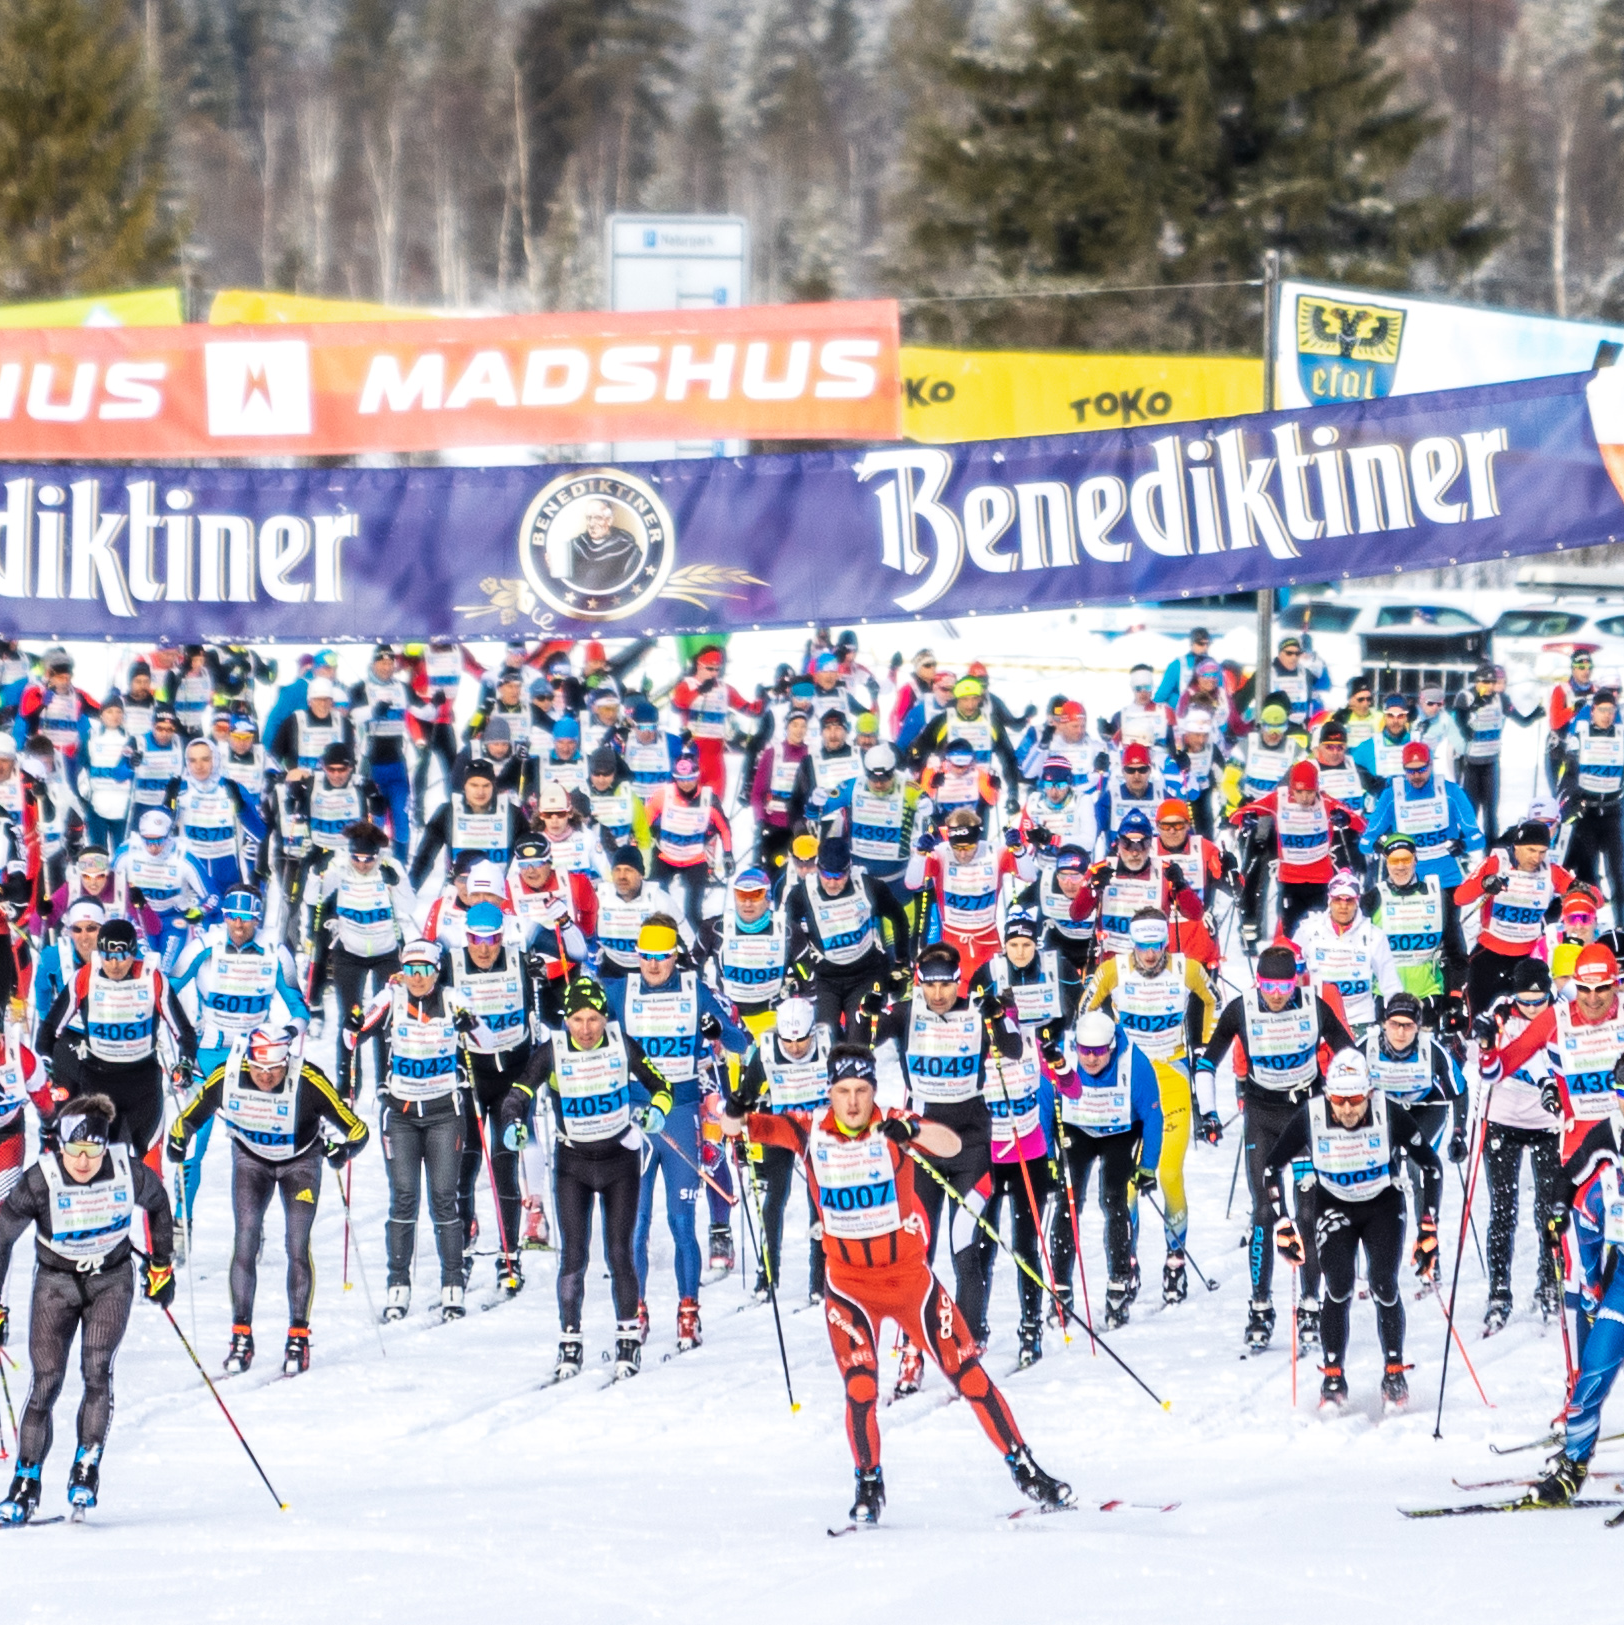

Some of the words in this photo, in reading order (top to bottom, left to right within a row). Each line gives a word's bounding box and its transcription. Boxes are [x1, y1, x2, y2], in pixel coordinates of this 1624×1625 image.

[358, 339, 881, 413] MADSHUS
[1069, 387, 1174, 425] TOKO
[530, 477, 662, 547] BENEDIKTINER
[851, 421, 1509, 613] Benediktiner
[728, 966, 780, 985] 4098
[213, 994, 267, 1013] 6011
[93, 1021, 149, 1041] 4061
[398, 1056, 453, 1078] 6042
[912, 1056, 975, 1077] 4049
[565, 1091, 622, 1117] 4051
[824, 1181, 889, 1210] 4007
[1252, 1226, 1265, 1286] salomon
